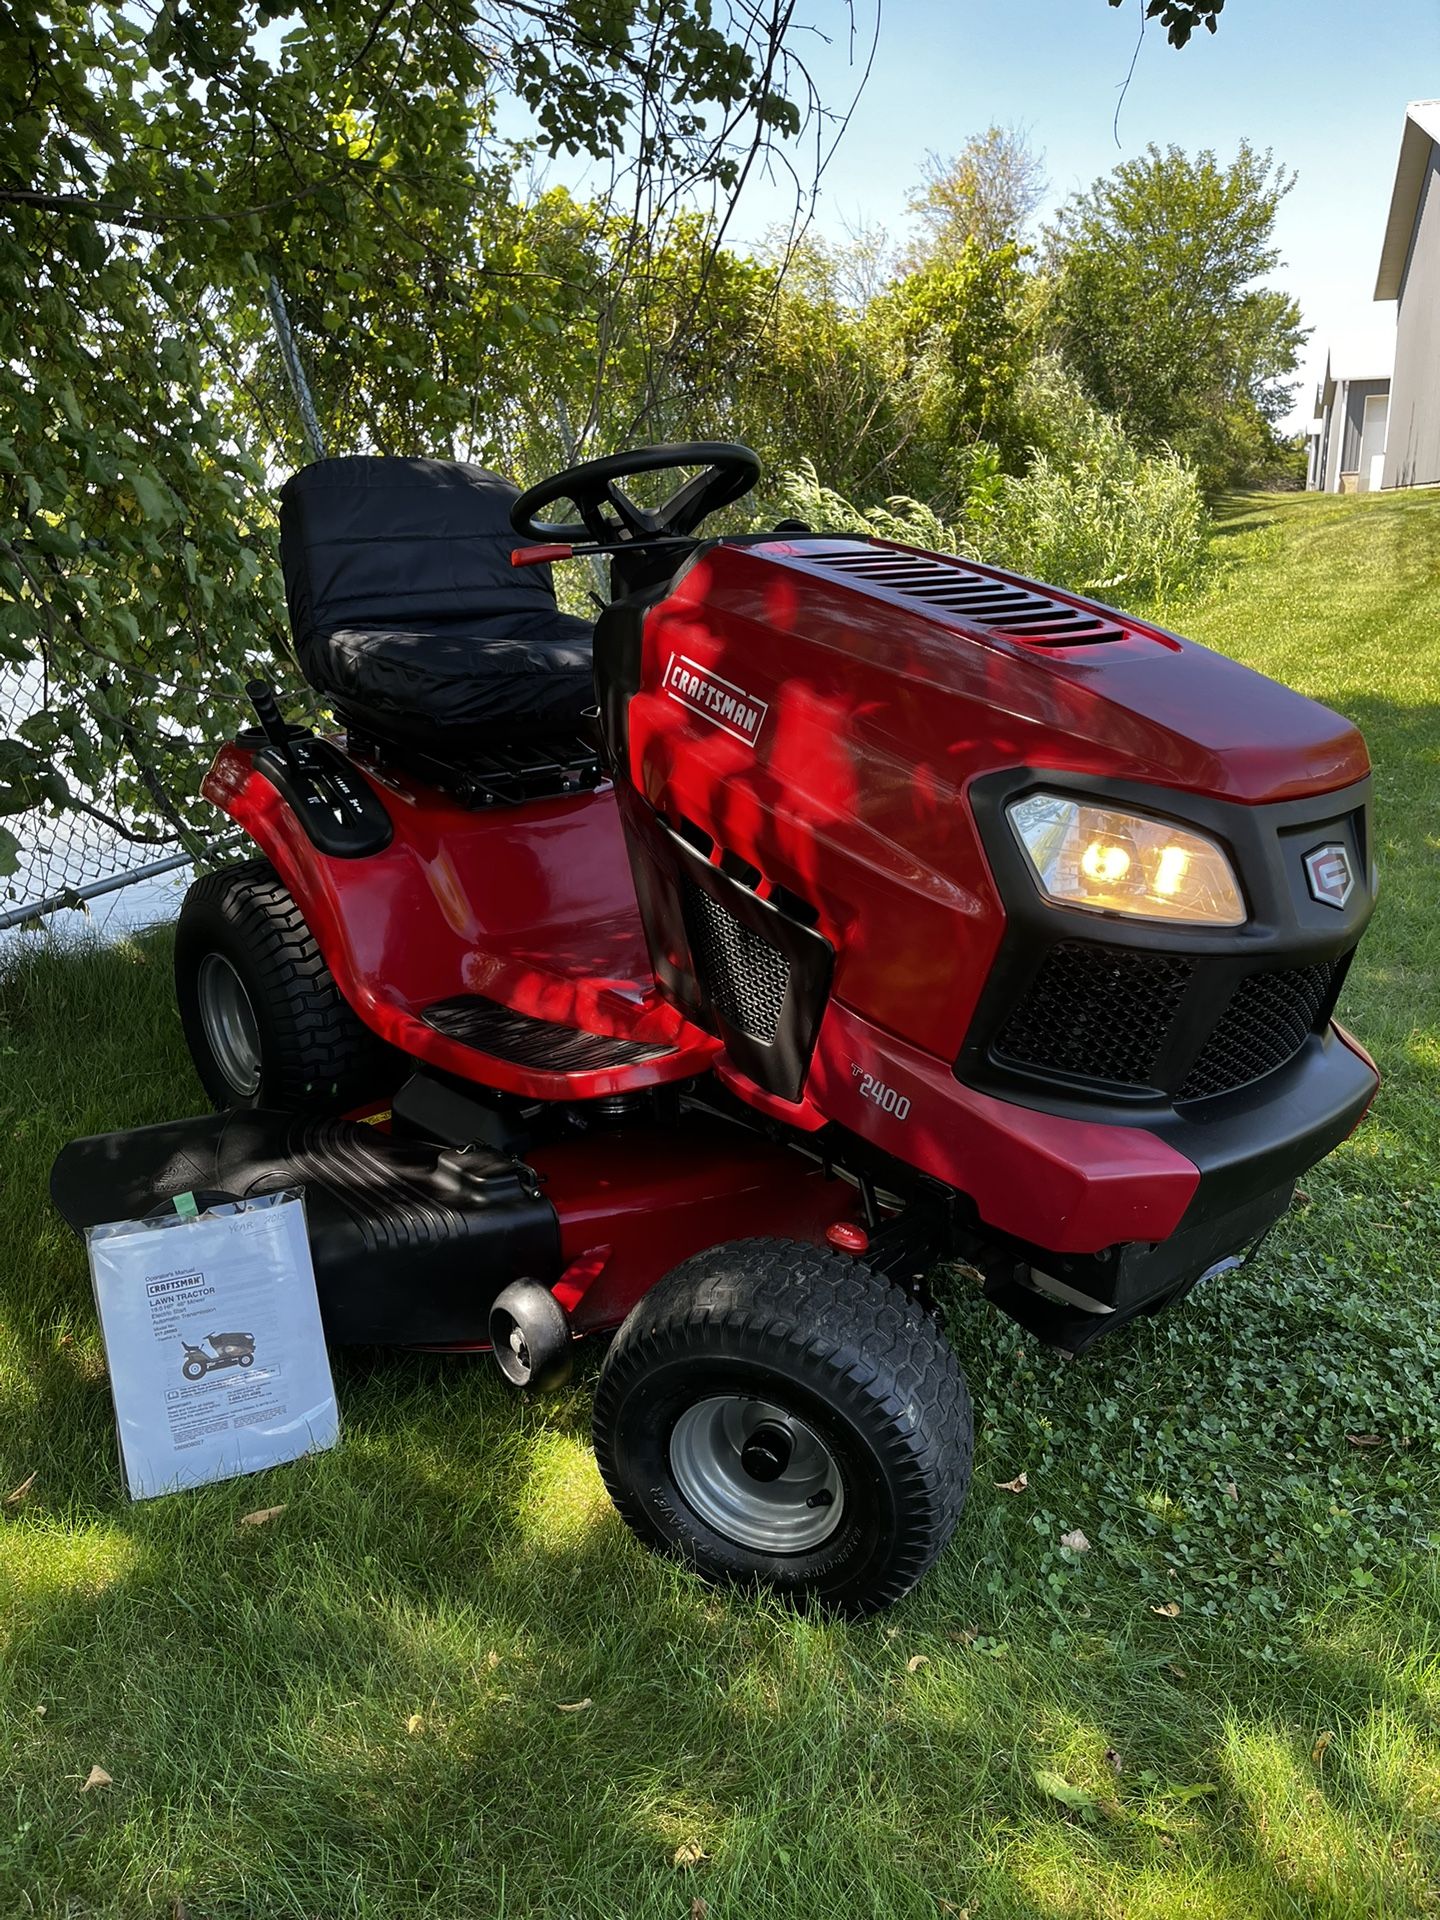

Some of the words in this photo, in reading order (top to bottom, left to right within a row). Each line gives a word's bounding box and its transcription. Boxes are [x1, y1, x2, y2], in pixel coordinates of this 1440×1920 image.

[670, 665, 758, 733] CRAFTSMAN
[149, 1275, 201, 1294] CRAFTSMAN
[149, 1295, 175, 1307] LAWN
[176, 1286, 215, 1301] TRACTOR
